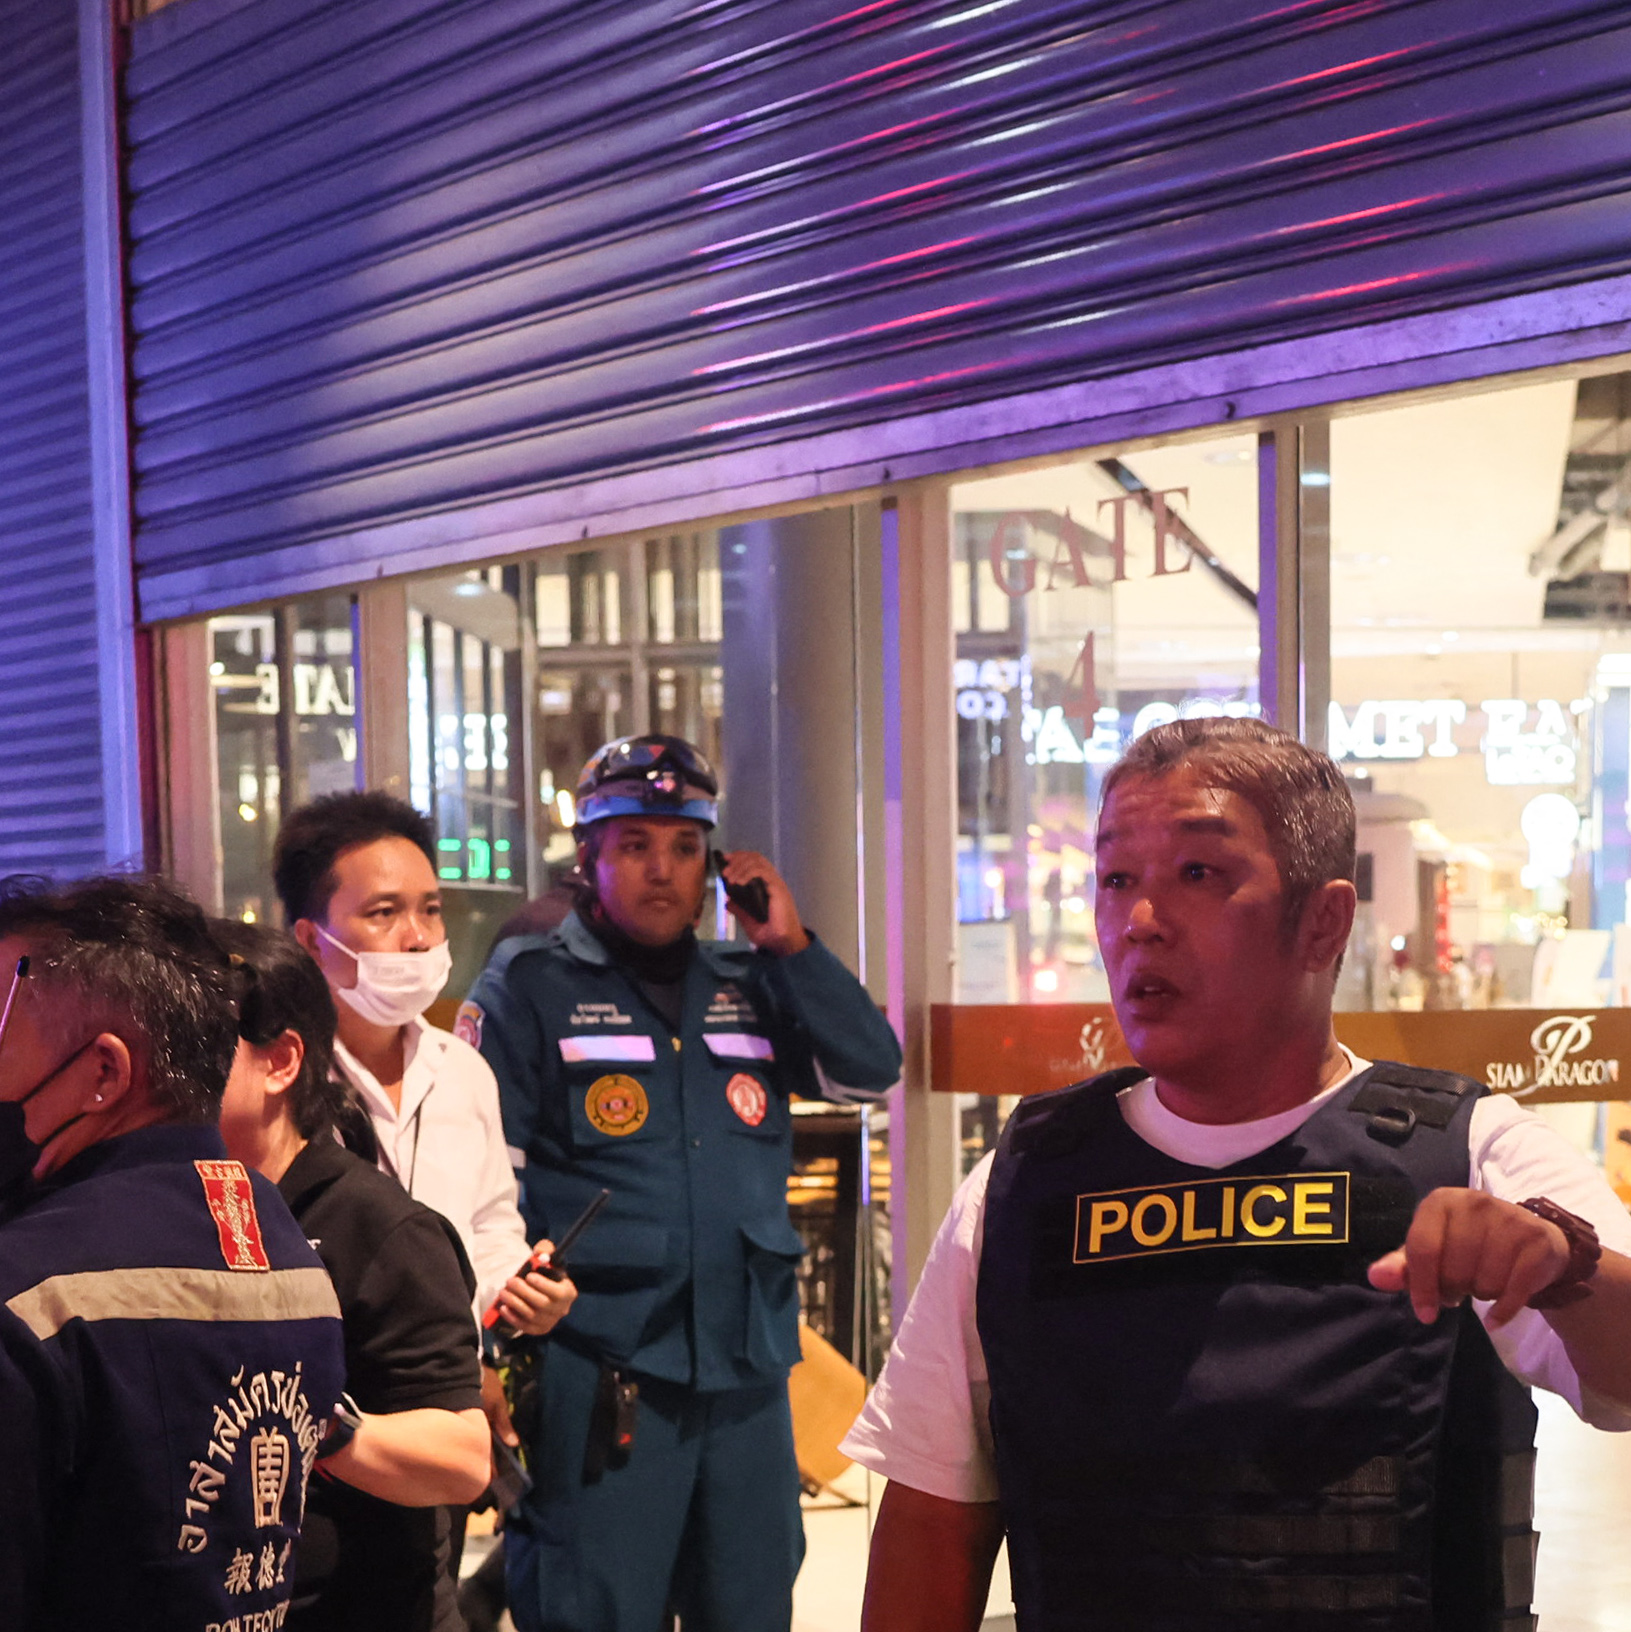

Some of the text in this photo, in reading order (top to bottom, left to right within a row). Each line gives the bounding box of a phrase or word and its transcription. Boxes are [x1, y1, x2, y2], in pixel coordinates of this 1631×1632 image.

[990, 487, 1197, 598] GATE
[1061, 631, 1102, 737] 4
[1088, 1182, 1334, 1253] POLICE
